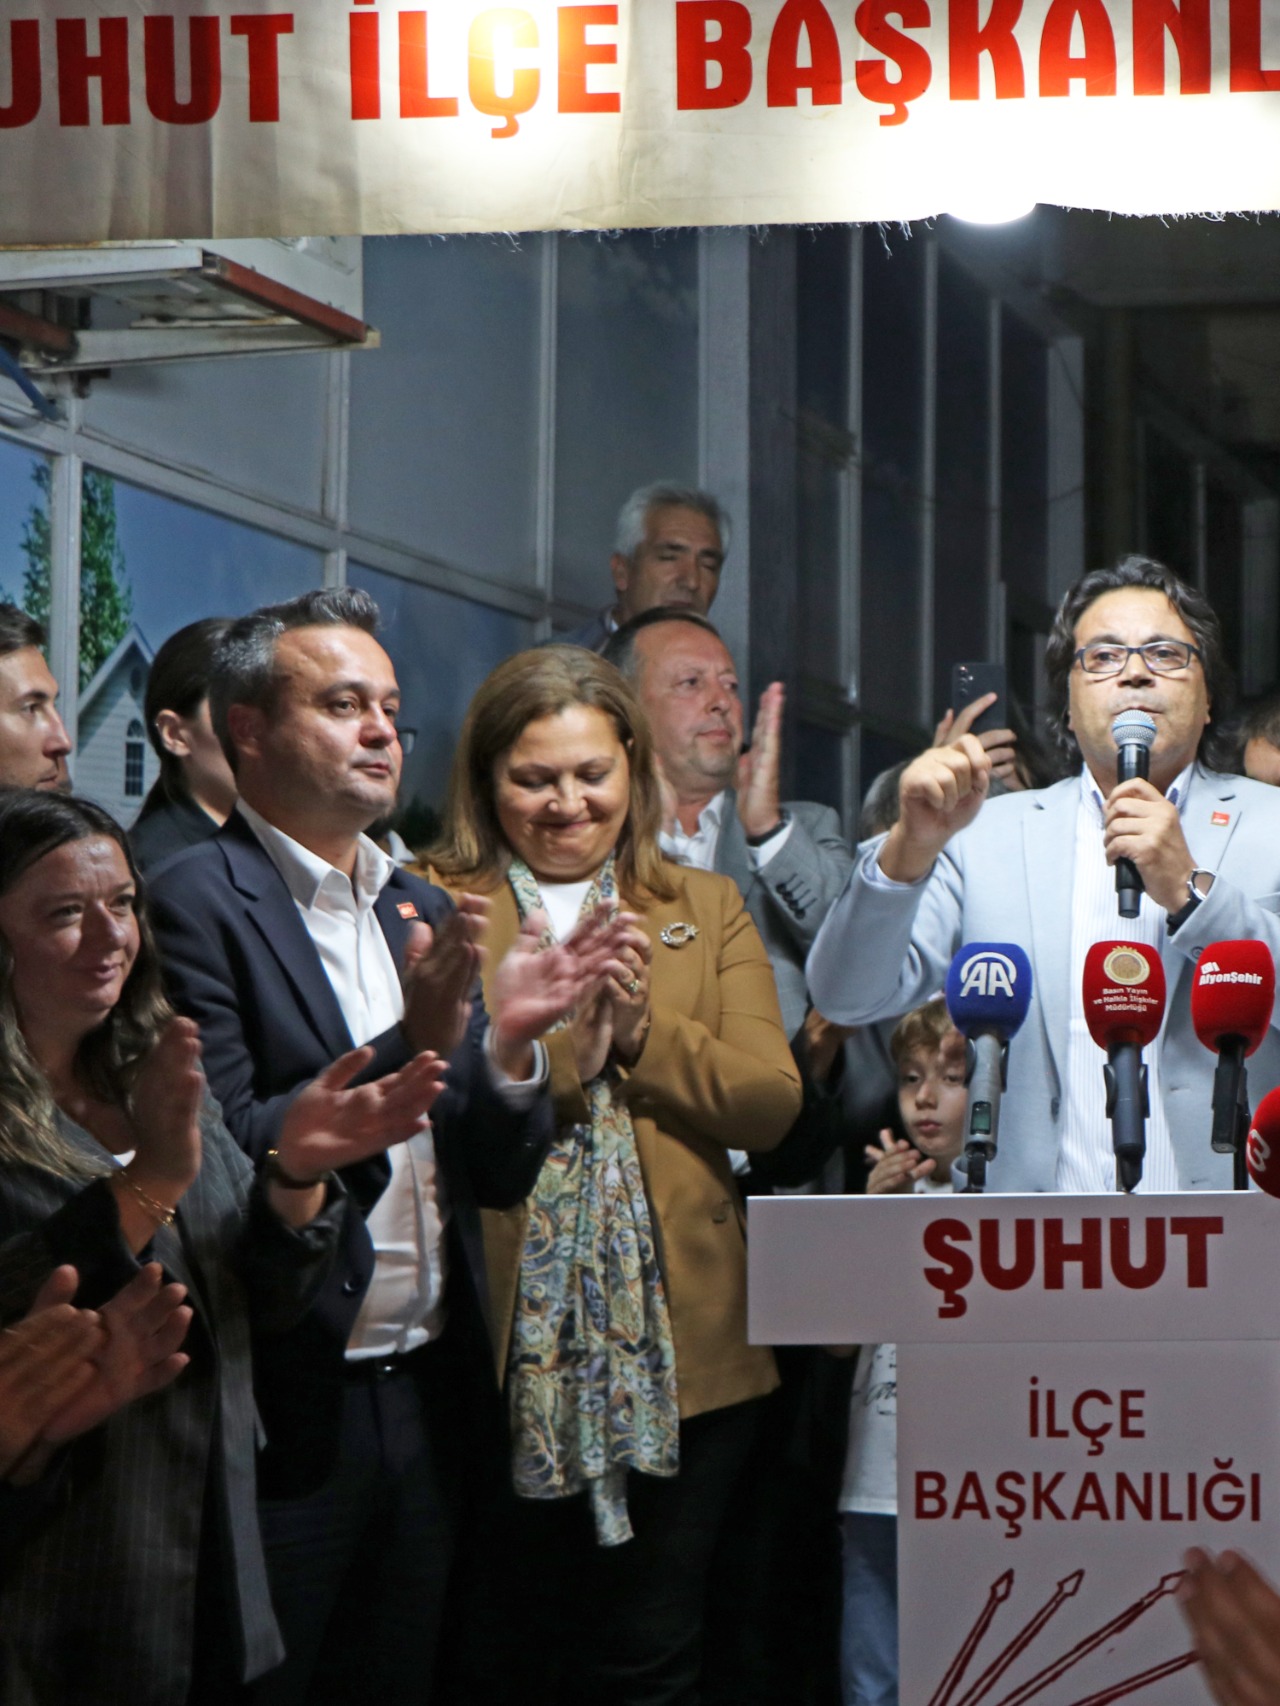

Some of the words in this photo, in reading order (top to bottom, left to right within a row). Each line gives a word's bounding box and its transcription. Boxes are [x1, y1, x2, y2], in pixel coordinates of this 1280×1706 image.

[349, 0, 621, 138] İLÇE
[960, 961, 1014, 997] AA
[923, 1216, 1224, 1319] ŞUHUT
[1028, 1376, 1146, 1456] İLÇE
[914, 1457, 1261, 1539] BAŞKANLIĞI
